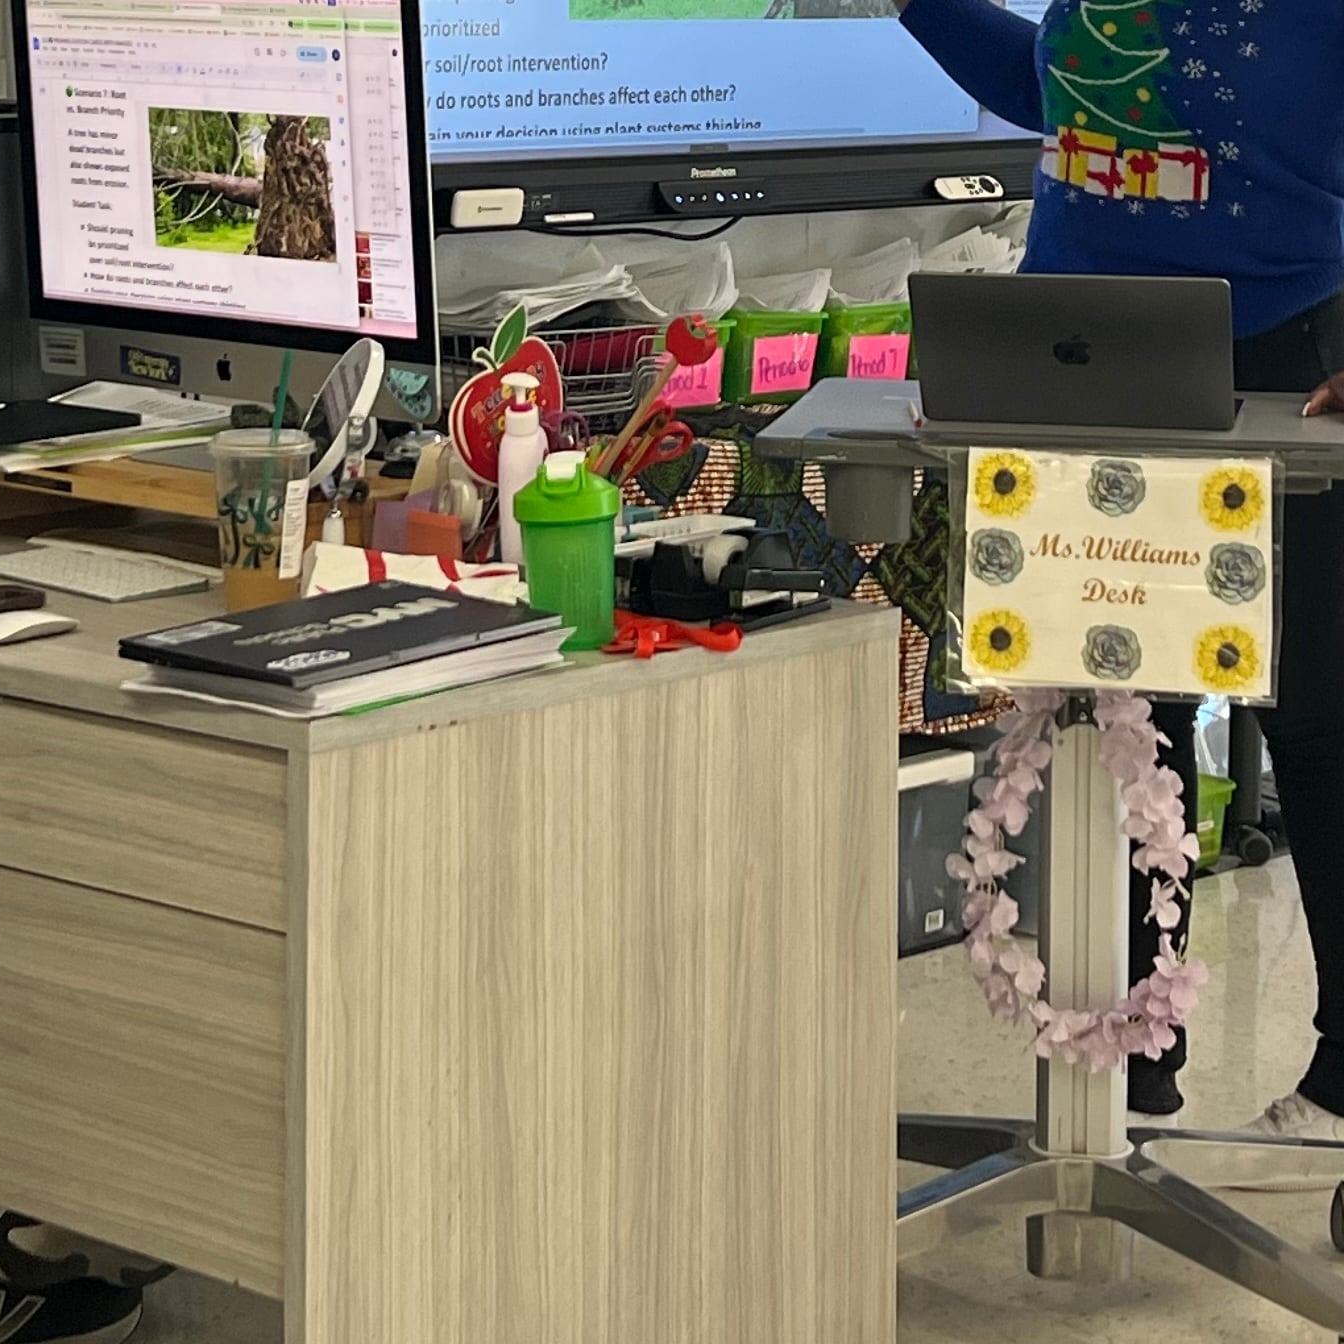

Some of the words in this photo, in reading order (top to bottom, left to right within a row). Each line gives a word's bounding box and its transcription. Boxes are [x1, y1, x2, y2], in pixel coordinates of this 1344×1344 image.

[435, 54, 503, 77] soil/root
[508, 52, 609, 73] intervention?
[436, 90, 456, 109] do
[461, 90, 500, 110] roots
[505, 89, 533, 107] and
[539, 88, 605, 108] branches
[609, 86, 651, 105] affect
[654, 85, 687, 104] each
[691, 83, 737, 103] other?
[758, 357, 797, 384] Period
[888, 348, 898, 372] 7
[698, 367, 708, 389] 1
[1081, 577, 1147, 606] Desk
